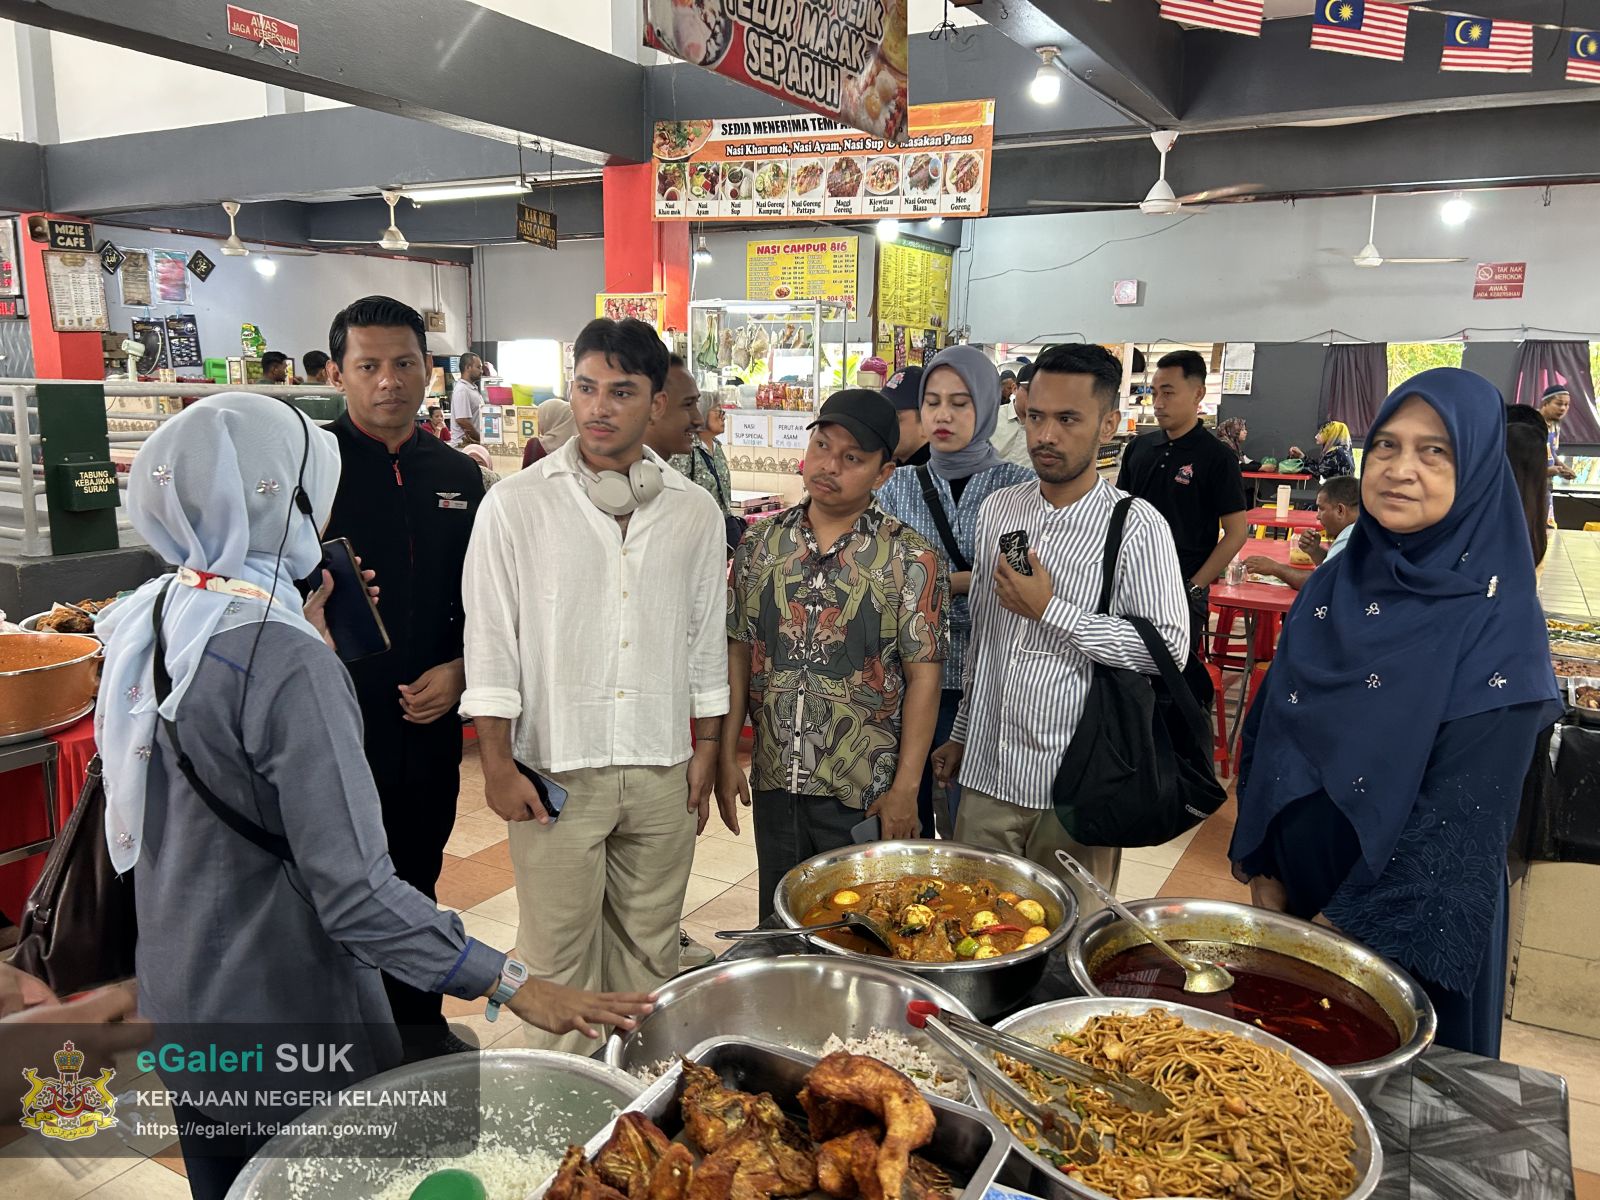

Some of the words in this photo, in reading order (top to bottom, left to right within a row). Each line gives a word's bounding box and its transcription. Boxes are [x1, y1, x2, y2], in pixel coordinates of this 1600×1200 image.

[232, 22, 251, 35] JAGA
[251, 16, 278, 33] AWAS
[800, 4, 865, 73] MASAK
[747, 28, 840, 107] SEPARUH
[721, 123, 751, 135] SEDIA
[753, 119, 809, 134] MENERIMA
[726, 145, 744, 156] Nasi
[745, 144, 768, 155] Khau
[769, 143, 791, 155] mok,
[793, 142, 812, 153] Nasi
[813, 141, 841, 154] Ayam,
[844, 140, 863, 150] Nasi
[865, 140, 883, 151] Sup
[944, 134, 973, 145] Panas
[803, 200, 821, 208] Goreng
[917, 197, 936, 205] Goreng
[55, 224, 84, 235] MIZIE
[56, 236, 86, 247] CAFE
[756, 246, 780, 254] NASI
[783, 243, 827, 254] CAMPUR
[830, 242, 847, 251] 816
[522, 420, 534, 436] B
[79, 471, 108, 479] TABUNG
[75, 478, 115, 487] KEBAJIKAN
[84, 485, 108, 493] SURAU
